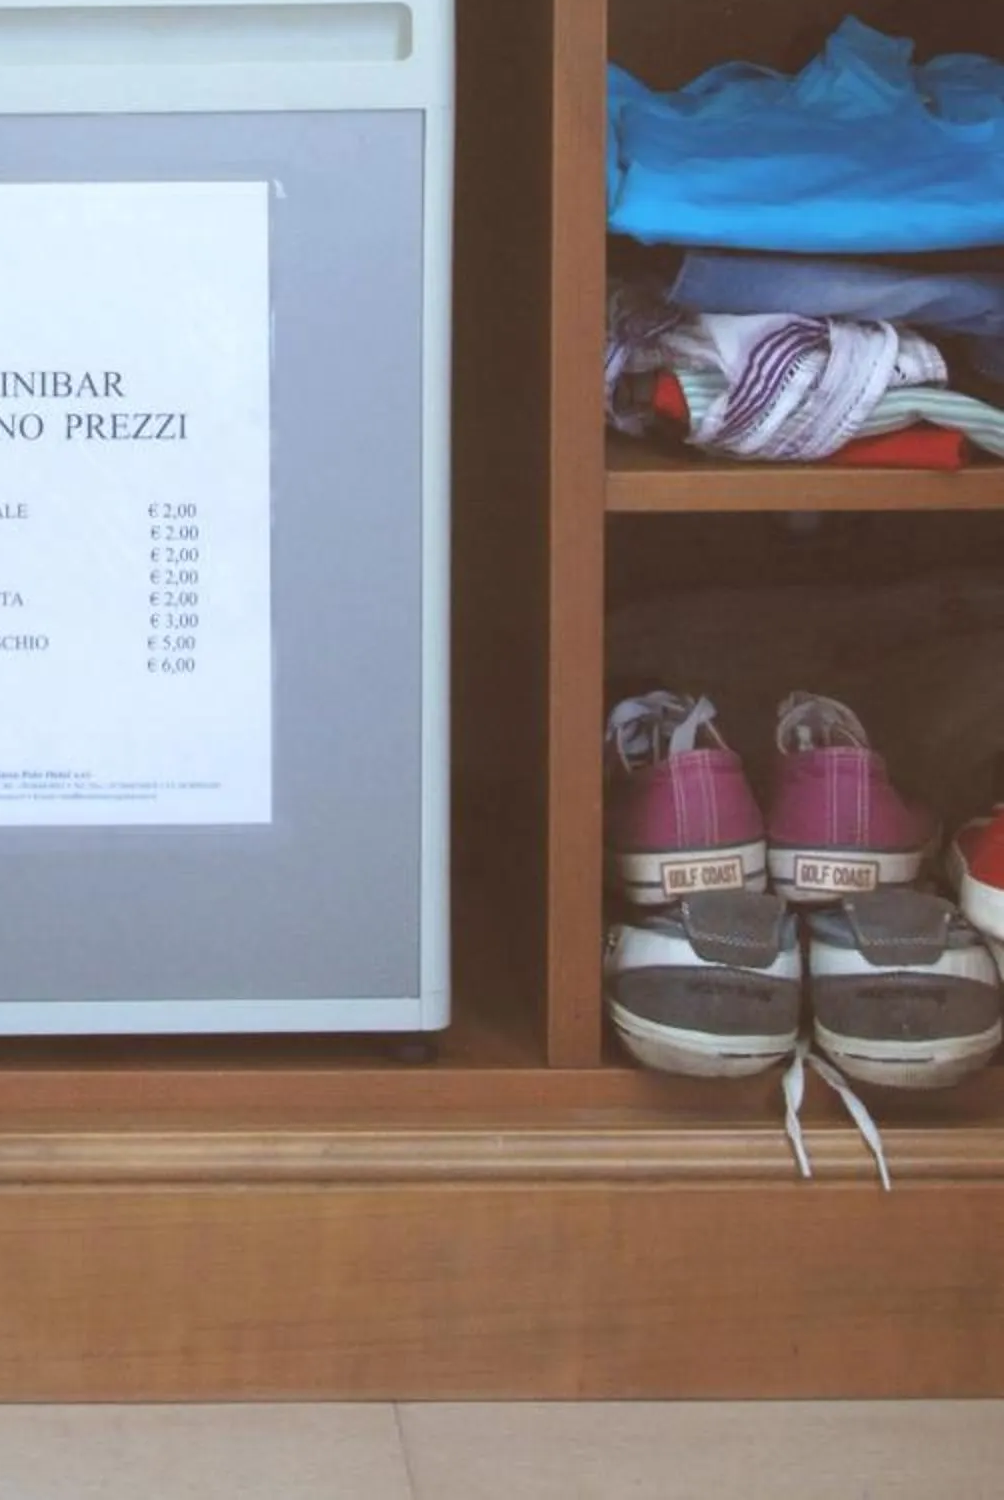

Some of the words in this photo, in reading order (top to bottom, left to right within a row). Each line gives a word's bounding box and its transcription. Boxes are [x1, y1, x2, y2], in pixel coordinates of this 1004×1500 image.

[65, 412, 188, 441] PREZZI
[148, 503, 159, 519] €
[163, 502, 198, 520] 2,00
[150, 525, 161, 541] €
[150, 547, 161, 563] €
[165, 547, 200, 565] 2,00
[150, 569, 161, 585] €
[164, 569, 199, 587] 2,00
[149, 591, 160, 607] €
[163, 590, 199, 609] 2,00
[150, 612, 161, 629] €
[165, 612, 200, 630] 3,00
[147, 635, 158, 651] €
[162, 634, 197, 653] 5,00
[147, 657, 157, 673] €
[161, 657, 196, 675] 6,00
[668, 867, 698, 889] GOLF
[701, 863, 738, 887] COAST
[800, 863, 832, 885] GOLF
[833, 865, 872, 888] COAST
